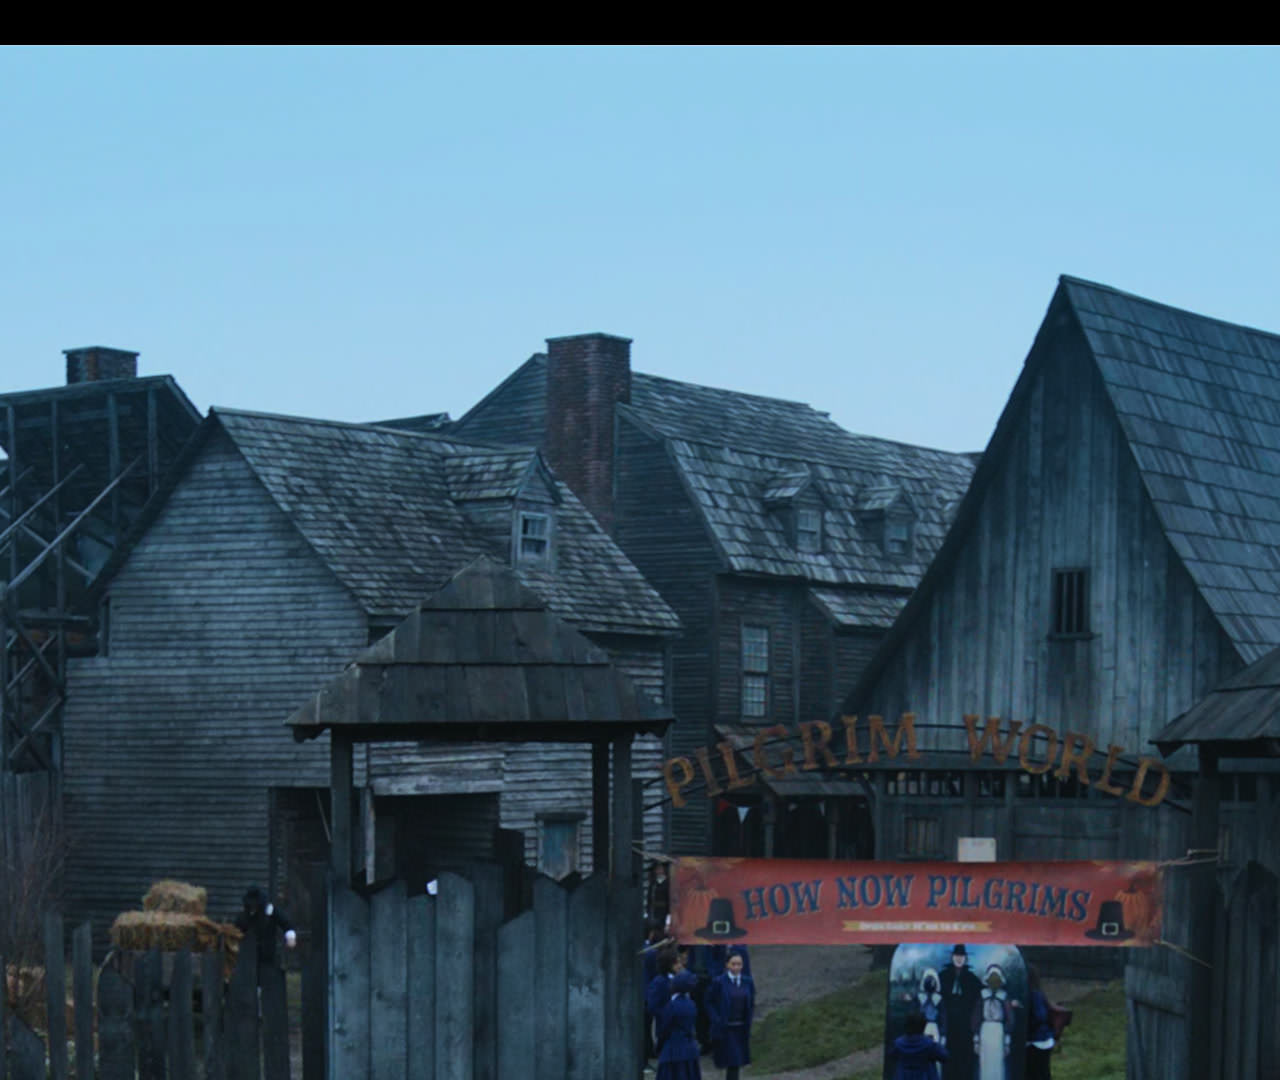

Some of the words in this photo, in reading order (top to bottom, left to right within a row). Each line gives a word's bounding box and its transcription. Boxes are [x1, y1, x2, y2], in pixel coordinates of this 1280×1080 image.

[662, 711, 921, 808] PILGRIM
[963, 713, 1171, 807] WORLD
[742, 879, 822, 920] HOW
[835, 874, 915, 909] NOW
[926, 874, 1093, 922] PILGRIMS
